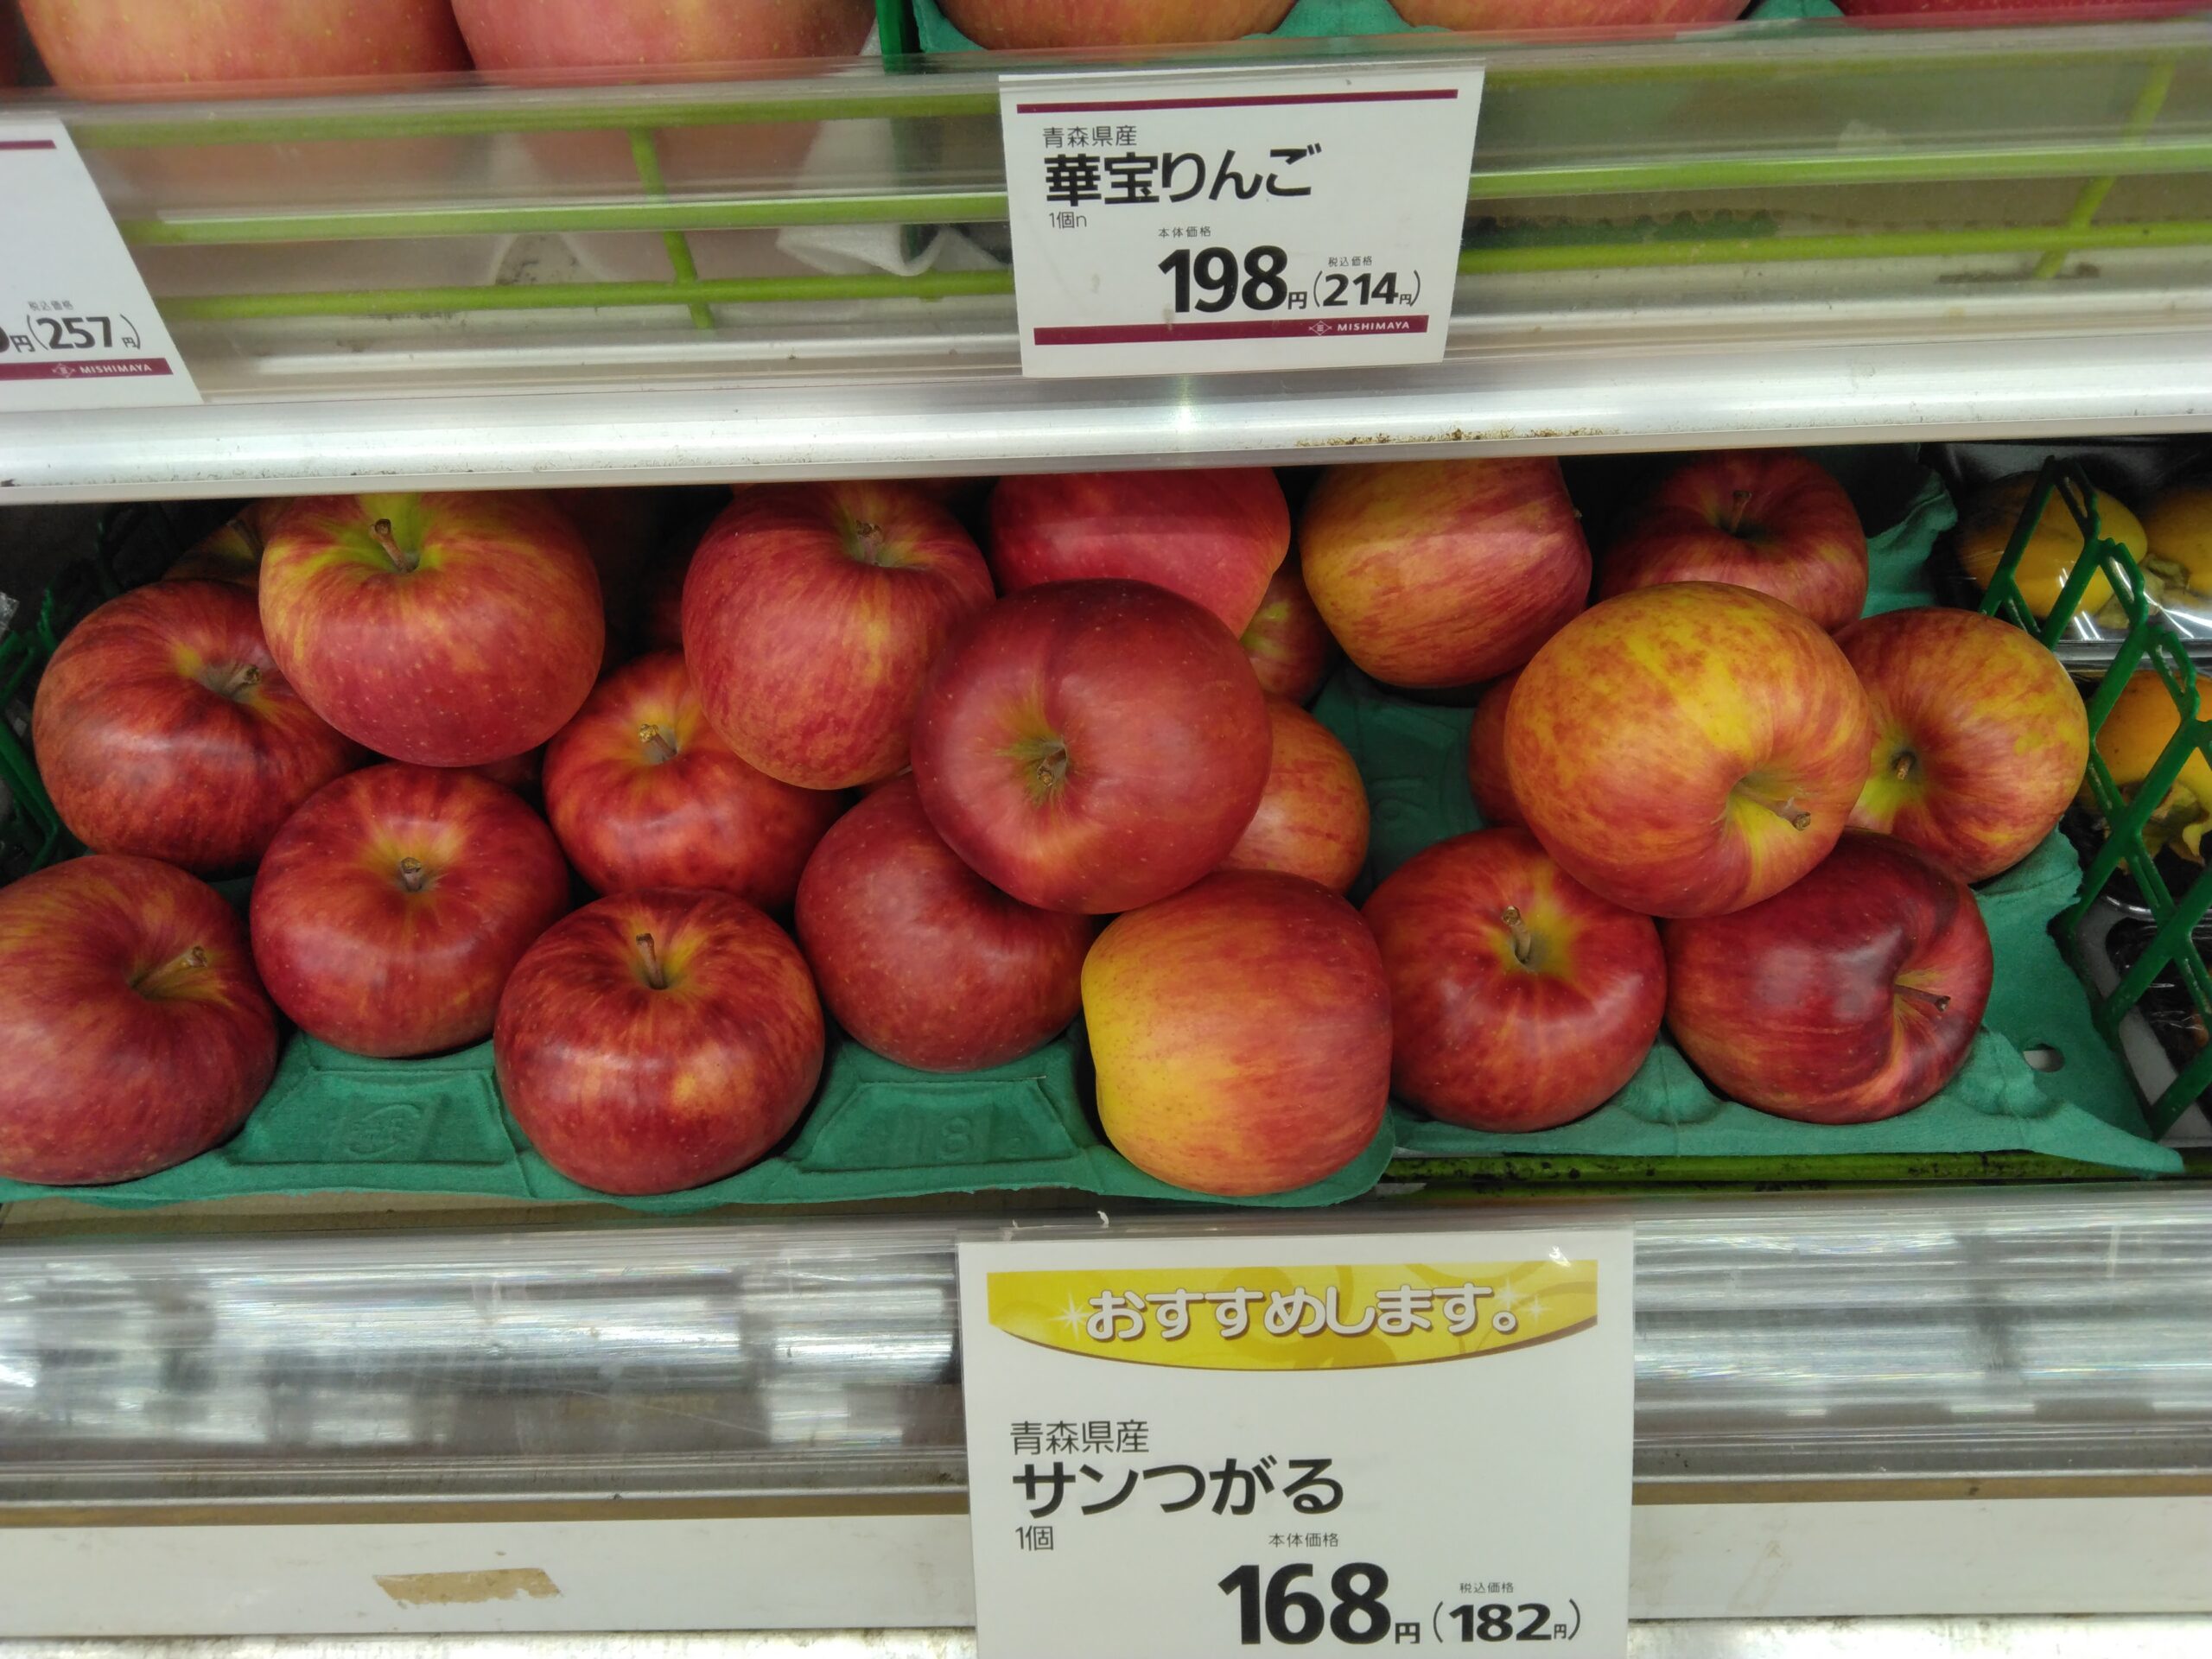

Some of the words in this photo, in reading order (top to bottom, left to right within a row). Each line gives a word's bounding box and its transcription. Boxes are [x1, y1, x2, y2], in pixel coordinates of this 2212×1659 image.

[1043, 124, 1137, 149] 青森県産
[1044, 143, 1322, 207] 華宝りんご
[1158, 226, 1211, 238] 本体価格
[1327, 256, 1373, 268] 税込価格
[1337, 321, 1410, 332] MISHIMAYA
[79, 363, 152, 374] MISHIMAYA
[1085, 1282, 1518, 1341] おすすめします。
[1009, 1419, 1150, 1455] 青森県産
[1013, 1456, 1344, 1517] サンつがる
[1014, 1526, 1053, 1551] 1個
[1268, 1532, 1339, 1548] 本体価格
[1459, 1582, 1514, 1593] 税込価格
